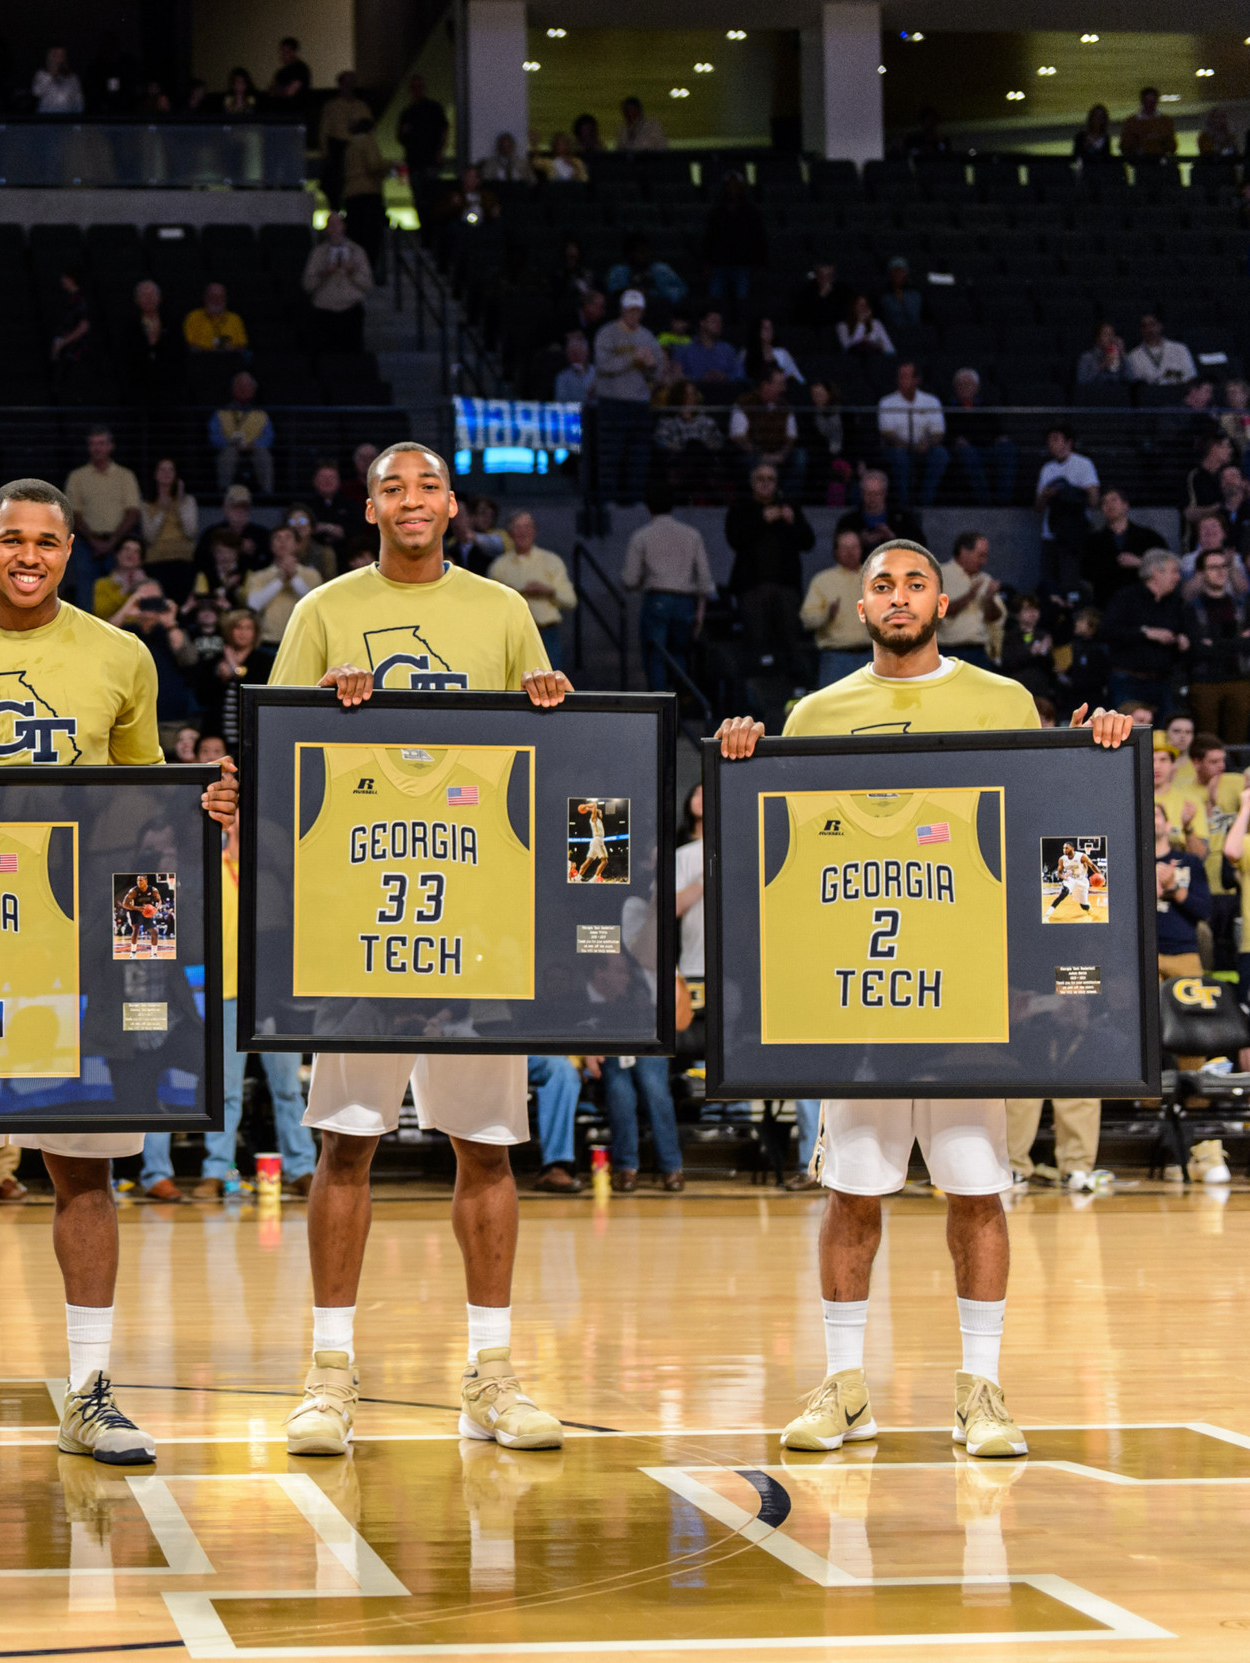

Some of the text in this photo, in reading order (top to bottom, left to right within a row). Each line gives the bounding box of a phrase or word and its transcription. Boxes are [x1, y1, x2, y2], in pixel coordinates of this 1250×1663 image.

[350, 819, 478, 865] GEORGIA
[375, 872, 447, 925] 33
[820, 859, 956, 904] GEORGIA
[359, 934, 463, 975] TECH
[867, 907, 902, 960] 2
[834, 968, 943, 1009] TECH
[1172, 978, 1222, 1010] GT
